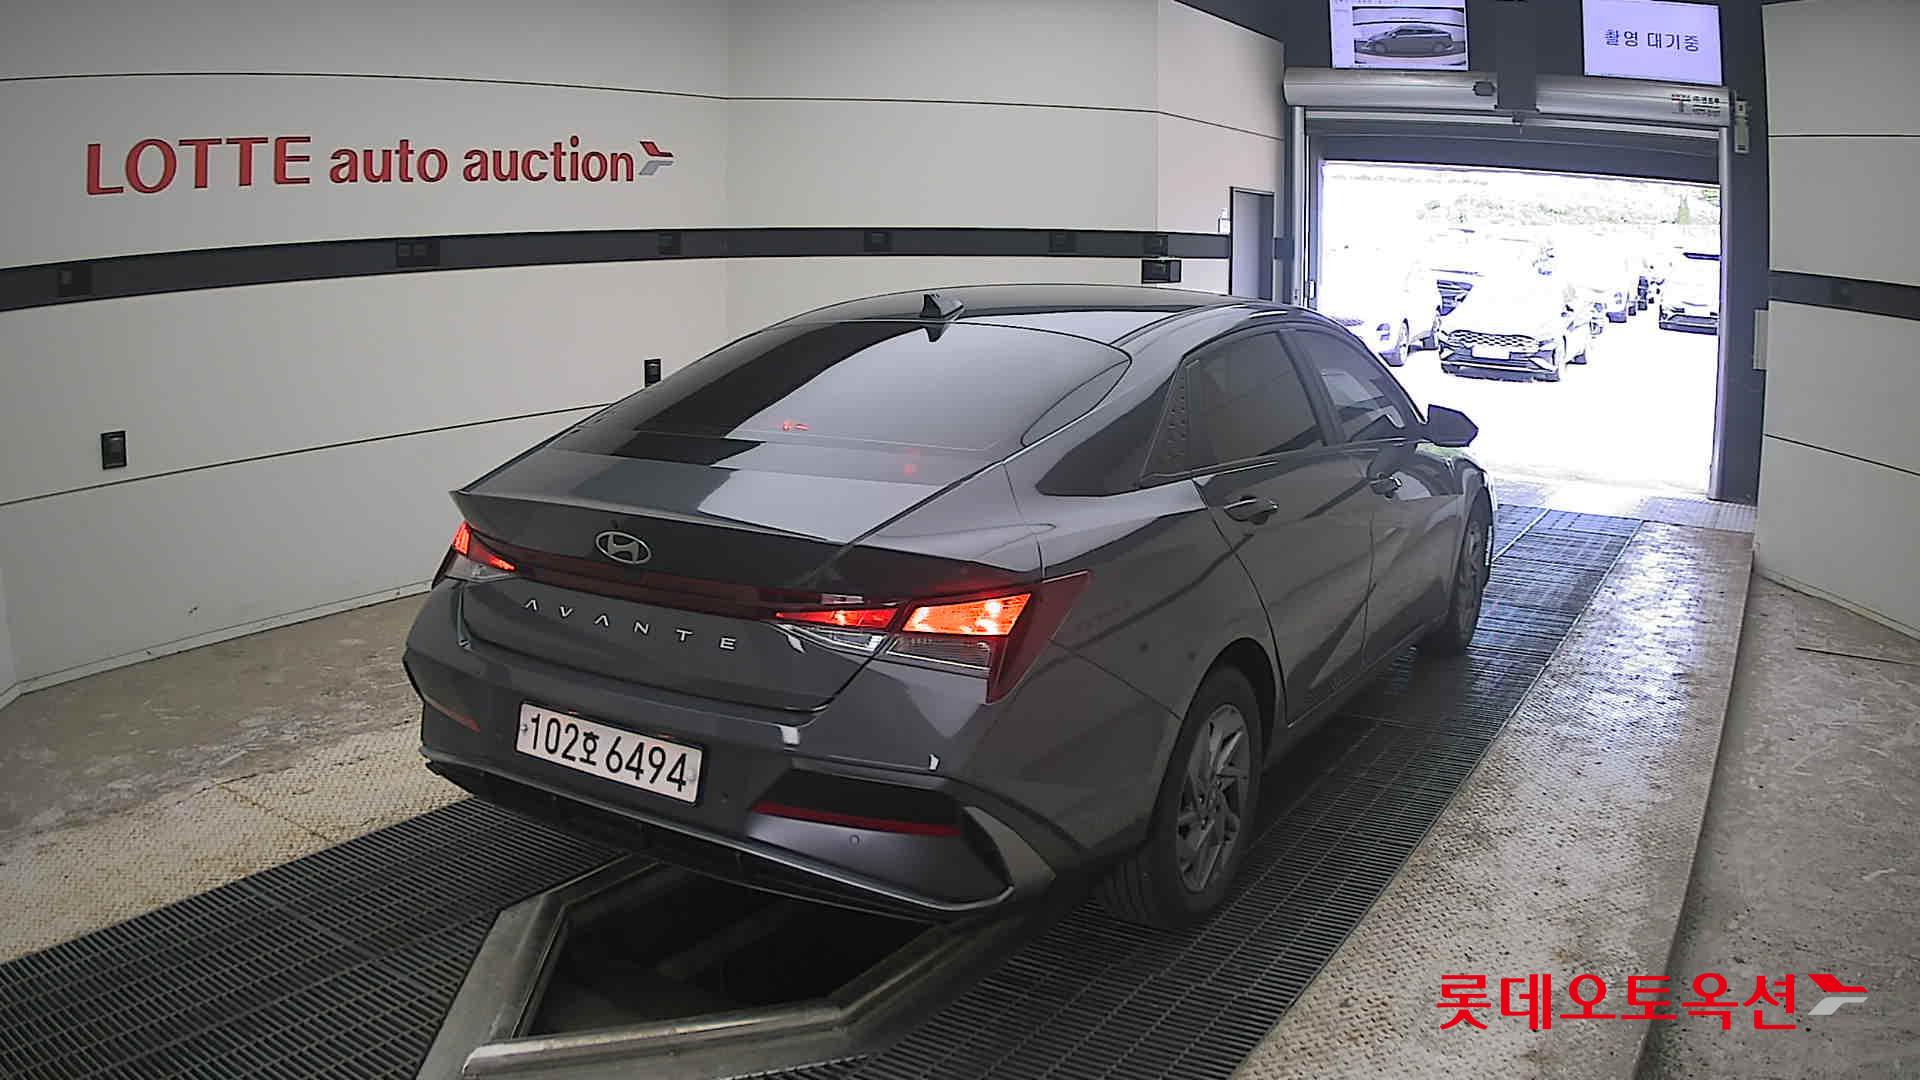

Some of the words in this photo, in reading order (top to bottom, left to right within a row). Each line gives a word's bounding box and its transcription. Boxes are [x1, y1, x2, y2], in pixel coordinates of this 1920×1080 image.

[1647, 32, 1699, 52] 대기중
[86, 136, 311, 195] LOTTE
[329, 139, 448, 183] auto
[463, 135, 634, 182] auction
[524, 599, 737, 650] AVANTE
